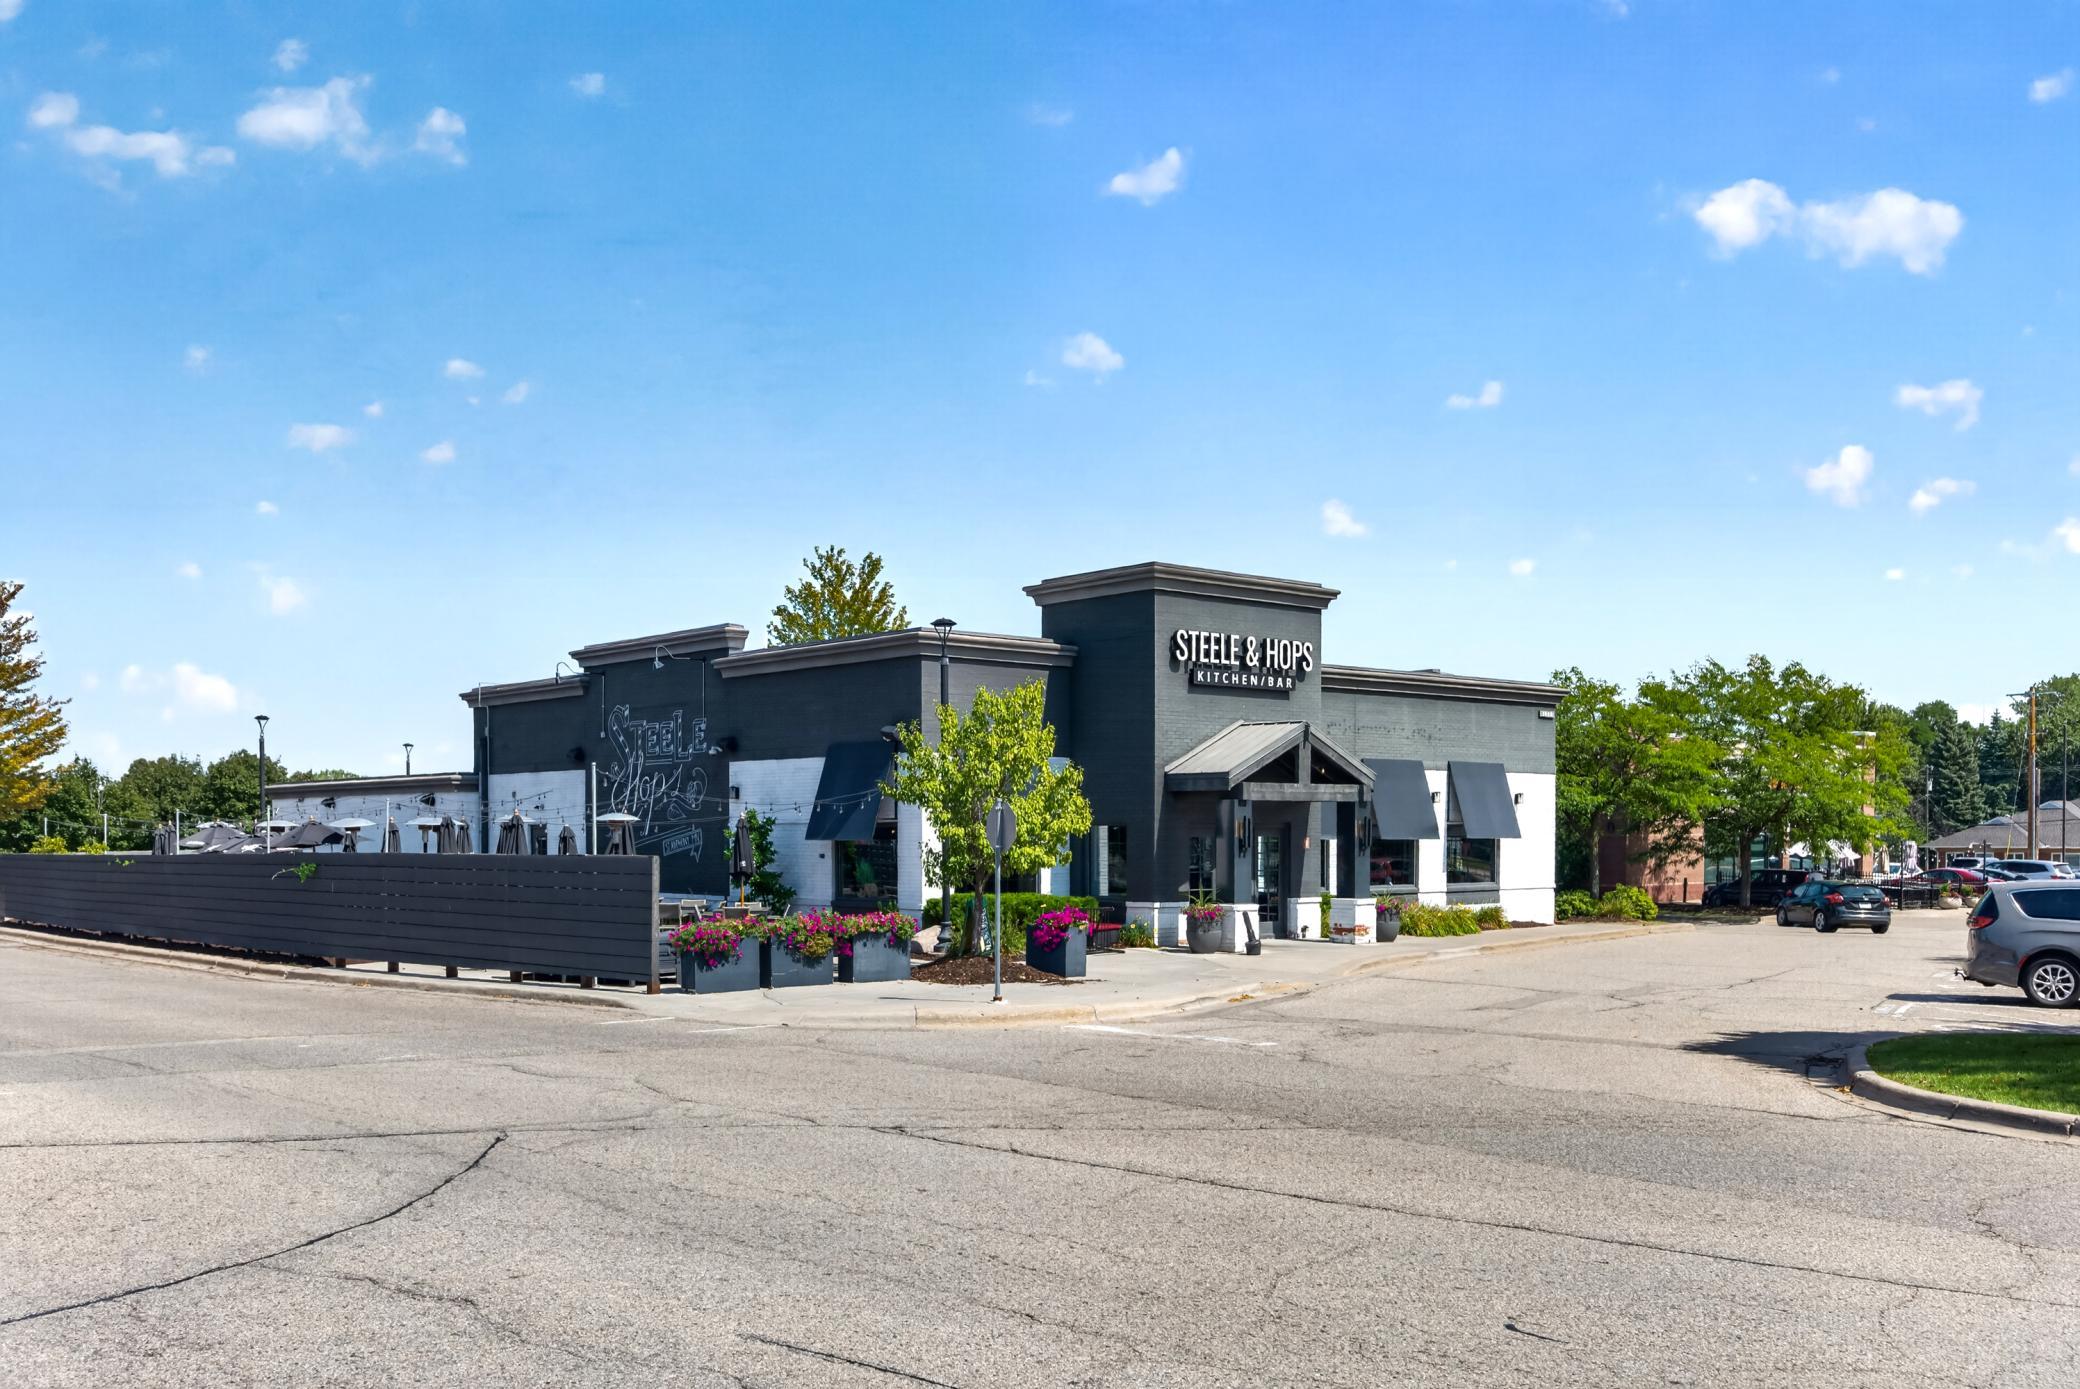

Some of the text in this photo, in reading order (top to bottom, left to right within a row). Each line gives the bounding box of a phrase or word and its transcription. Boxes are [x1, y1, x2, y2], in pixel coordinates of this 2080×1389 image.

[1176, 629, 1313, 672] STEELE & HOPS
[1197, 670, 1293, 689] KITCHEN/BAR
